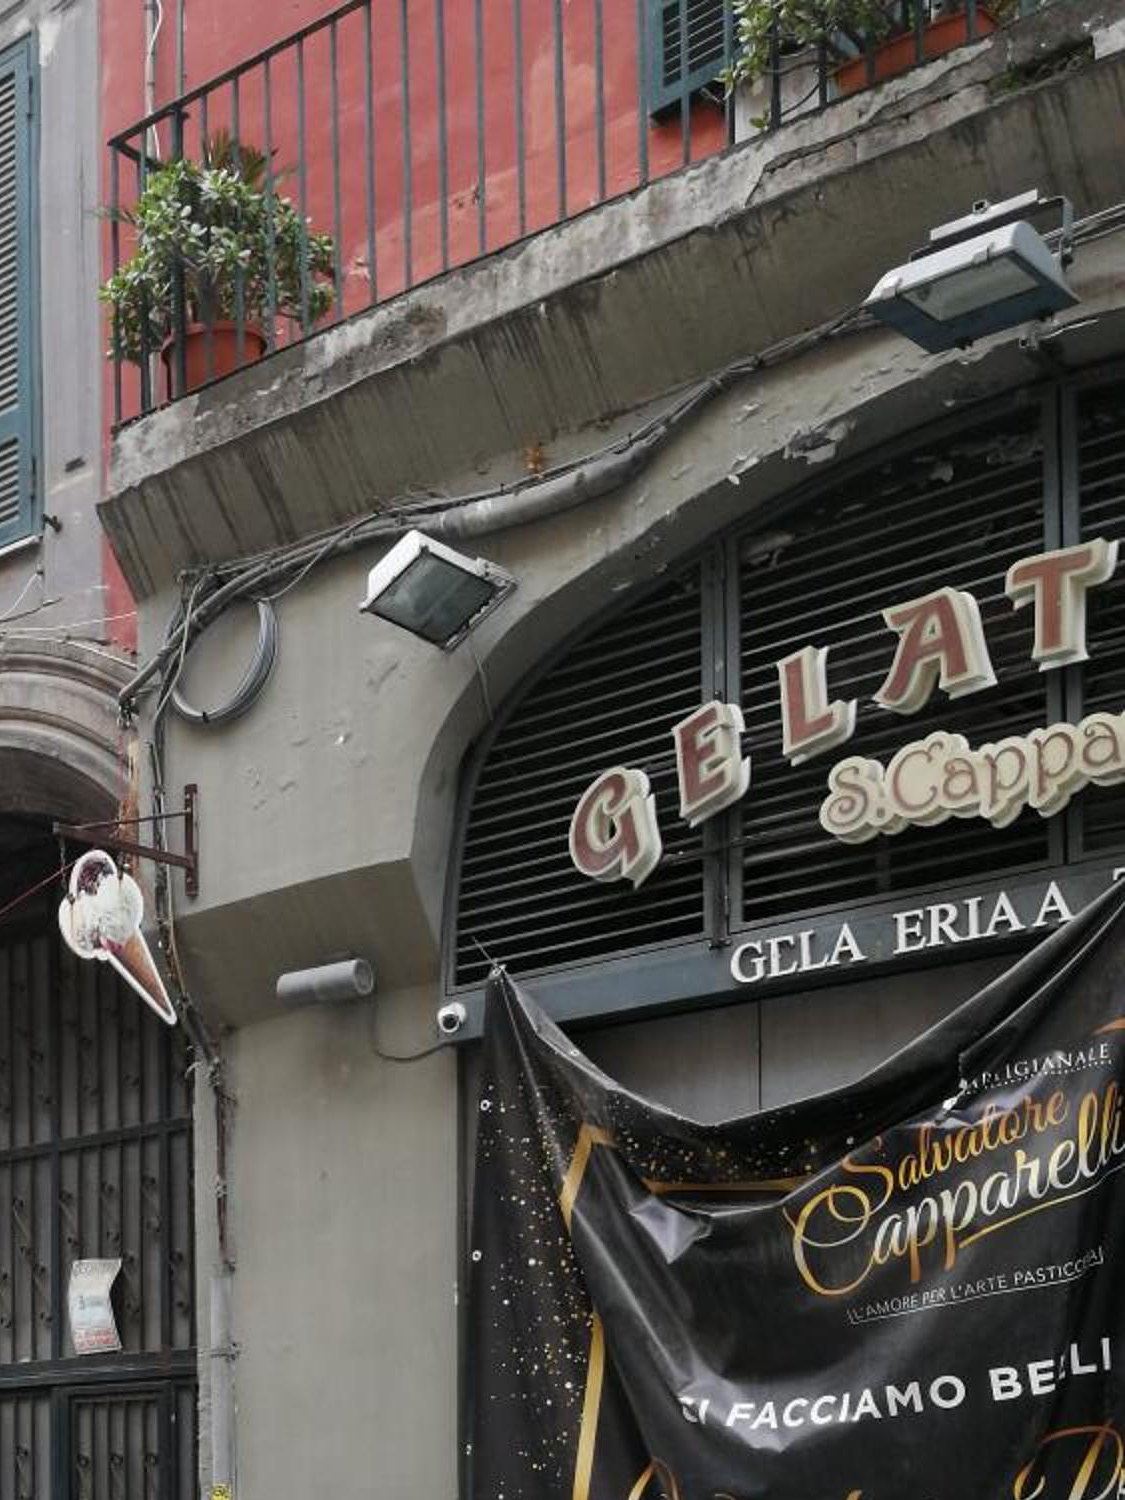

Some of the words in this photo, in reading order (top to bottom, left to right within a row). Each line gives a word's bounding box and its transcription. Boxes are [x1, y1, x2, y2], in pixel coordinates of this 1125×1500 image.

[827, 1090, 1065, 1223] Salvatore
[922, 1287, 946, 1305] PER
[950, 1274, 1007, 1300] L'ARTE
[725, 1374, 967, 1430] FACCIAMO
